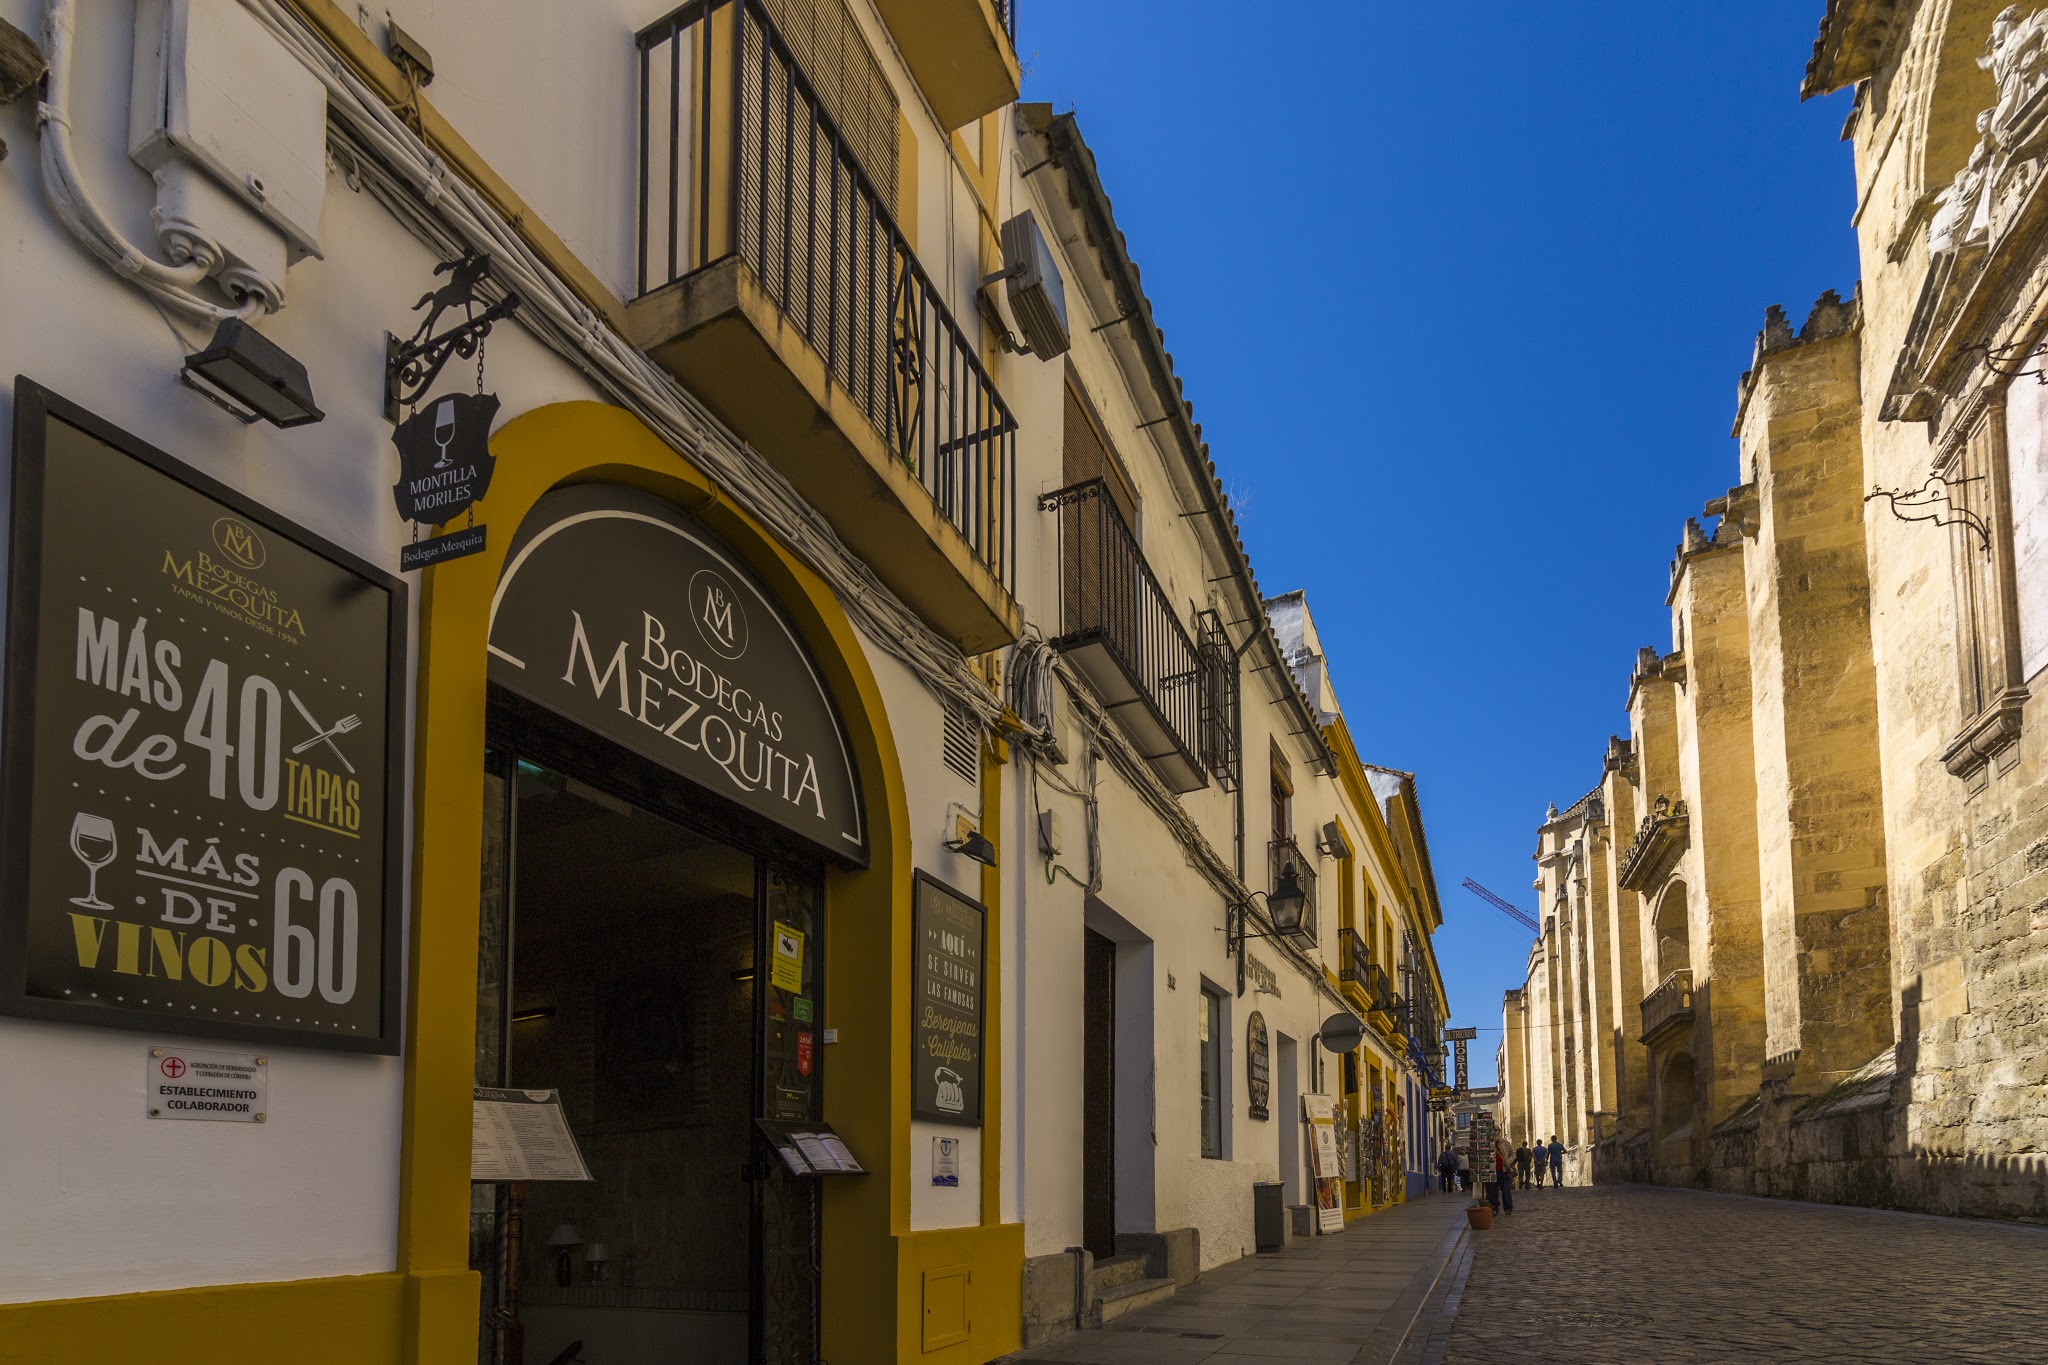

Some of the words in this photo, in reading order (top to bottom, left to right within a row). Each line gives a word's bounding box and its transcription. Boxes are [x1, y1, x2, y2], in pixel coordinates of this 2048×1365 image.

[410, 465, 477, 495] MONTILLA
[414, 484, 471, 512] MORILES
[403, 547, 439, 563] Bodegas
[441, 534, 483, 554] Mezquita
[161, 549, 307, 637] MEZQUITA
[198, 551, 277, 602] BODEGAS
[171, 584, 204, 604] TAPAS
[206, 599, 213, 607] Y
[213, 603, 243, 621] VINOS
[245, 617, 275, 636] DESDE
[277, 631, 298, 646] 1998
[76, 606, 183, 713] MÁS
[641, 610, 783, 742] BODEGAS
[184, 658, 282, 811] 40
[560, 609, 827, 821] MEZQUITA
[72, 708, 188, 780] de
[285, 757, 360, 832] TAPAS
[136, 828, 260, 888] MÁS
[160, 888, 236, 935] DE
[68, 912, 268, 994] VINOS
[273, 867, 359, 1005] 60
[940, 930, 965, 958] AQUÍ
[928, 954, 938, 972] SE
[944, 961, 975, 987] SIRVEN
[927, 980, 940, 998] LAS
[944, 986, 975, 1010] FAMOSAS
[921, 1006, 978, 1039] Berenjenas
[1452, 1029, 1475, 1039] TRIUNFO
[928, 1034, 972, 1065] Califales
[1456, 1040, 1467, 1085] HOSTAL
[160, 1085, 256, 1099] ESTABLECIMIENTO
[168, 1100, 250, 1112] COLABORADOR
